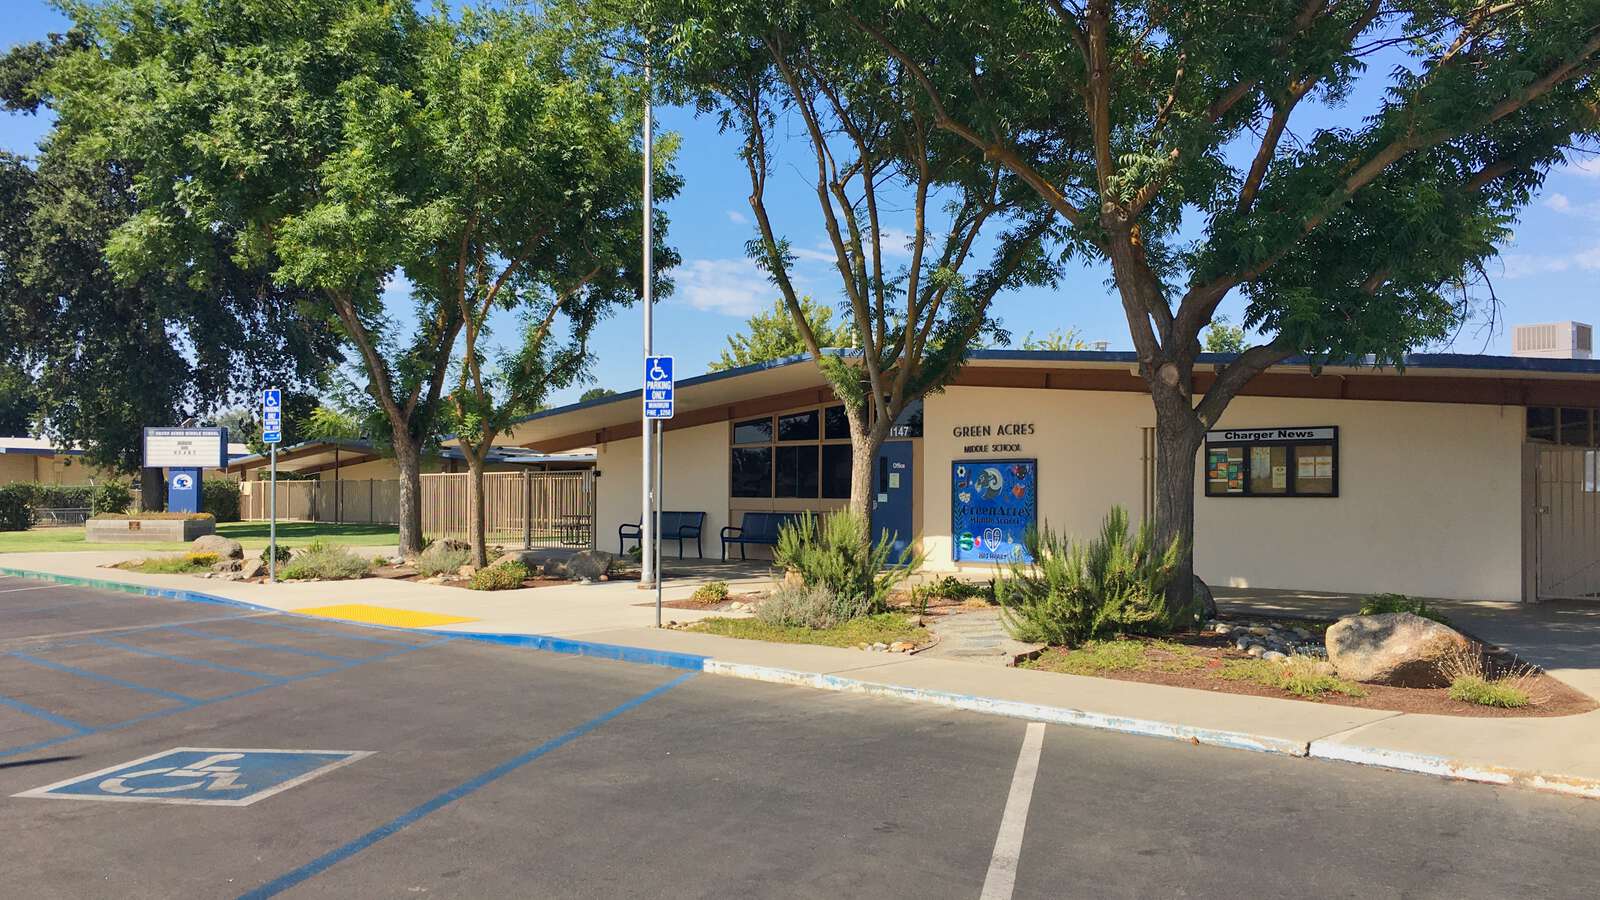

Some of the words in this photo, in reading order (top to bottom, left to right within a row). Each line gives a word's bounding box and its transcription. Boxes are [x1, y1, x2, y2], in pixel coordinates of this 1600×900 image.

[647, 380, 671, 390] PARKING
[652, 390, 666, 400] ONLY
[890, 426, 909, 437] 1147
[953, 425, 991, 438] GREEN
[997, 423, 1035, 436] ACRES
[1224, 431, 1274, 441] Charger
[1277, 430, 1314, 439] News
[964, 445, 989, 453] MIDDLE
[991, 444, 1021, 452] SCHOOL
